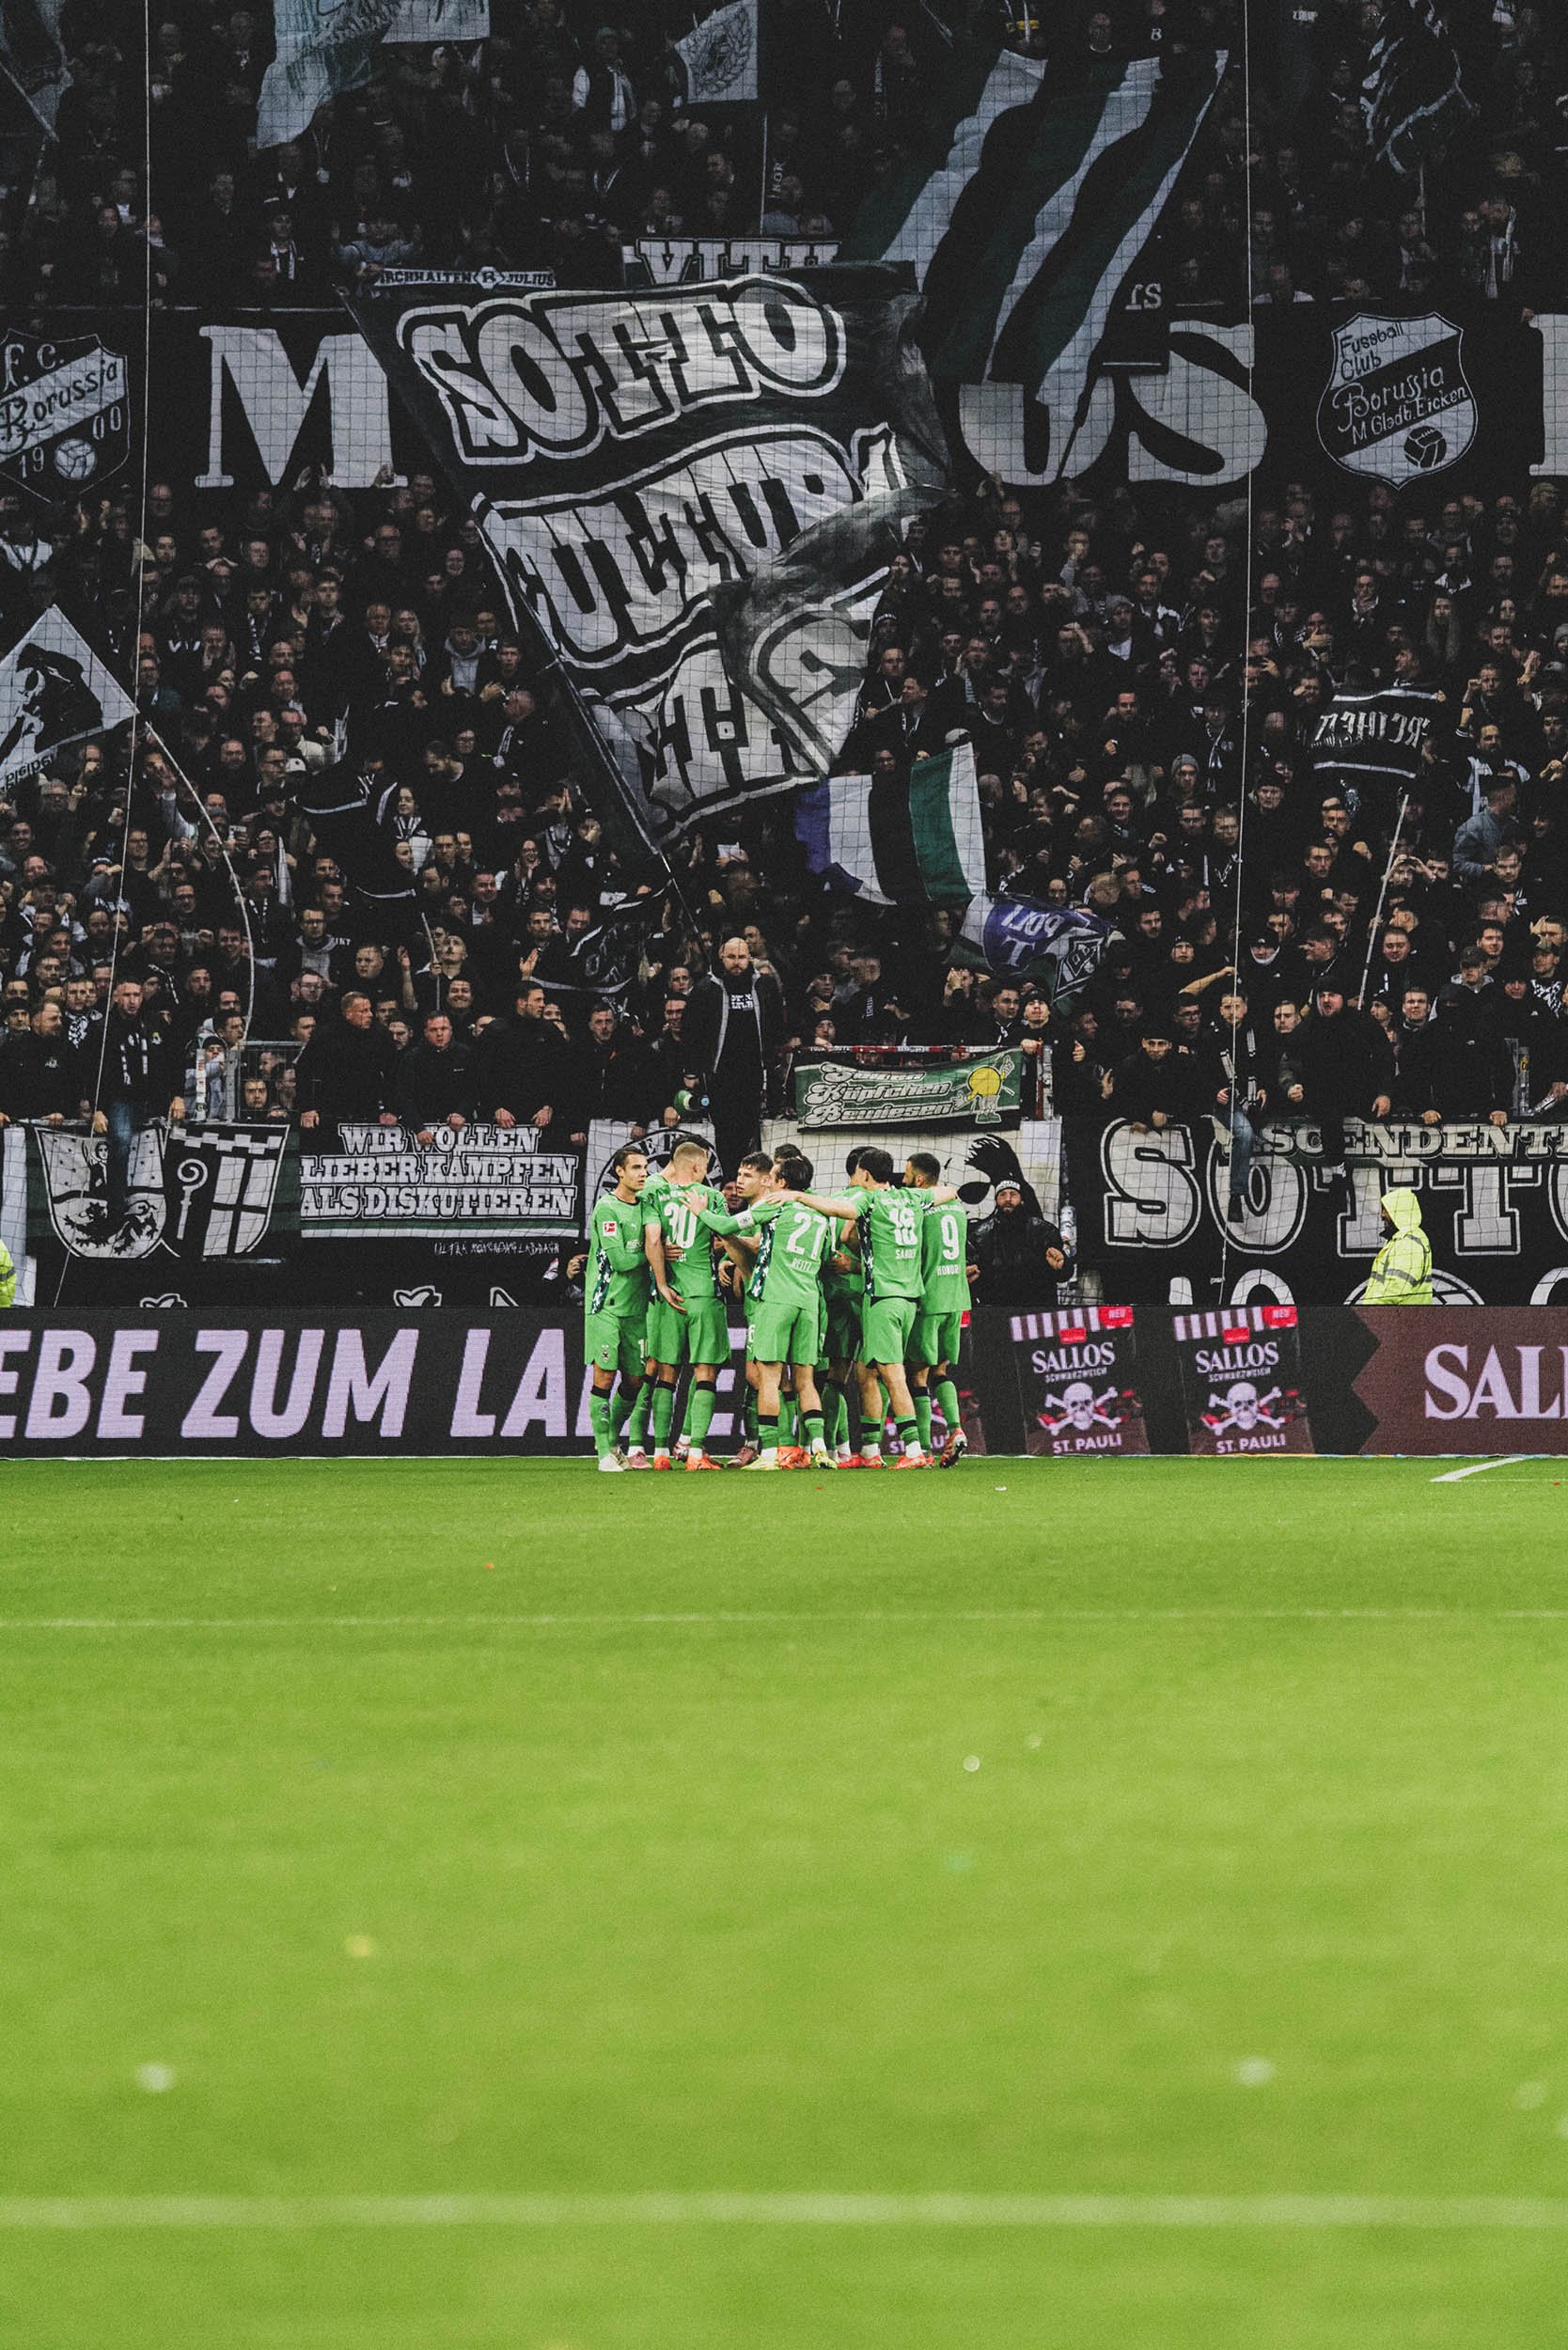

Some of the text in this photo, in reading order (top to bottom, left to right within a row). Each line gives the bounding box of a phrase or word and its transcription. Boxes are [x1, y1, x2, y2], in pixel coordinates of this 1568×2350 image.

[1340, 321, 1404, 359] Fussball
[399, 276, 841, 462] SOTTO
[1341, 351, 1382, 383] Club
[338, 1124, 406, 1155] WIR
[301, 1155, 422, 1185] LIEBER
[1102, 1117, 1568, 1258] SOTT
[301, 1184, 576, 1218] ALS DISKUTIEREN
[664, 1202, 697, 1249] 30
[787, 1212, 827, 1261] 27
[940, 1214, 960, 1261] 9
[1031, 1341, 1116, 1373] SALLOS
[1195, 1341, 1279, 1373] SALLOS
[180, 1329, 419, 1439] ZUM
[1424, 1343, 1568, 1420] SAL
[1075, 1434, 1121, 1450] PAULI
[1239, 1434, 1286, 1450] PAULI
